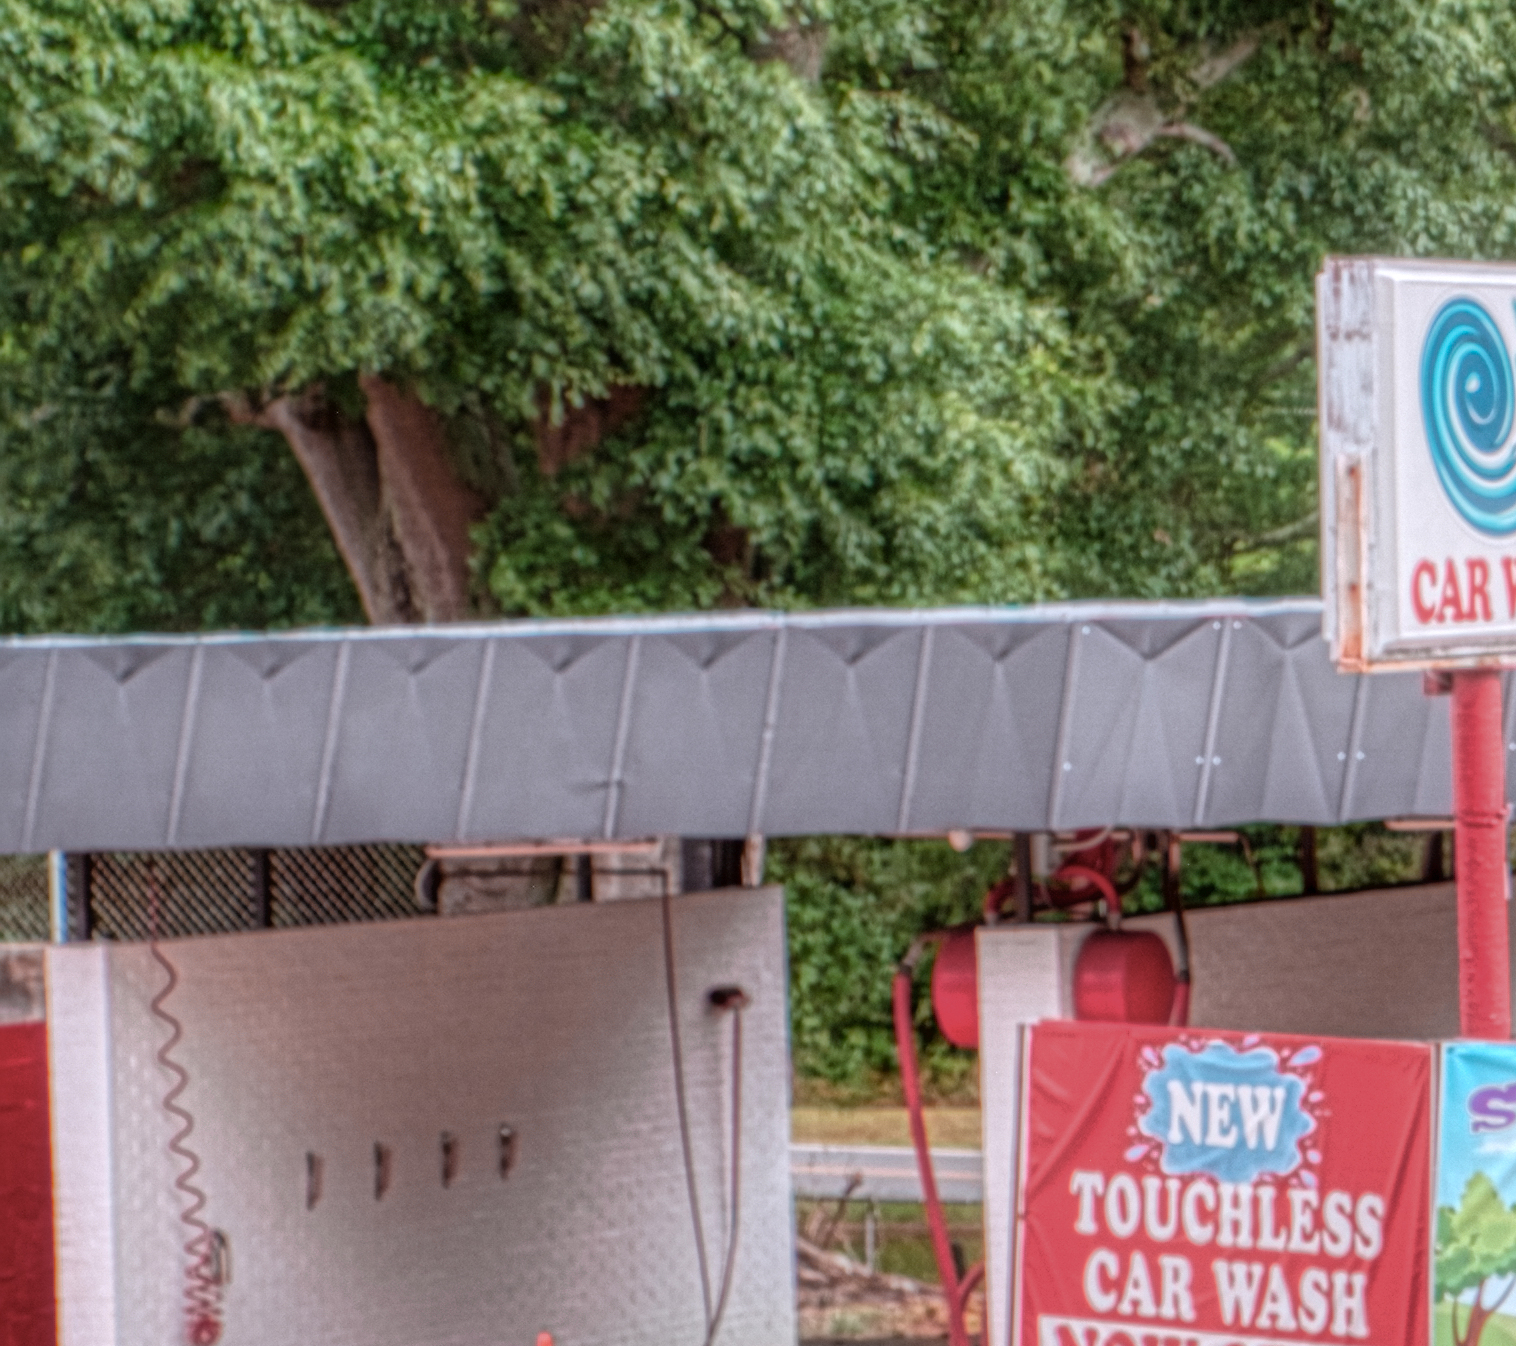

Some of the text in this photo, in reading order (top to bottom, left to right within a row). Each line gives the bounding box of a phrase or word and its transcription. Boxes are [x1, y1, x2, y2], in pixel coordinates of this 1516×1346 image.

[1411, 556, 1492, 624] CAR
[1167, 1080, 1286, 1151] NEW
[1069, 1169, 1384, 1260] TOUCHLESS
[1083, 1247, 1370, 1338] CAR WASH
